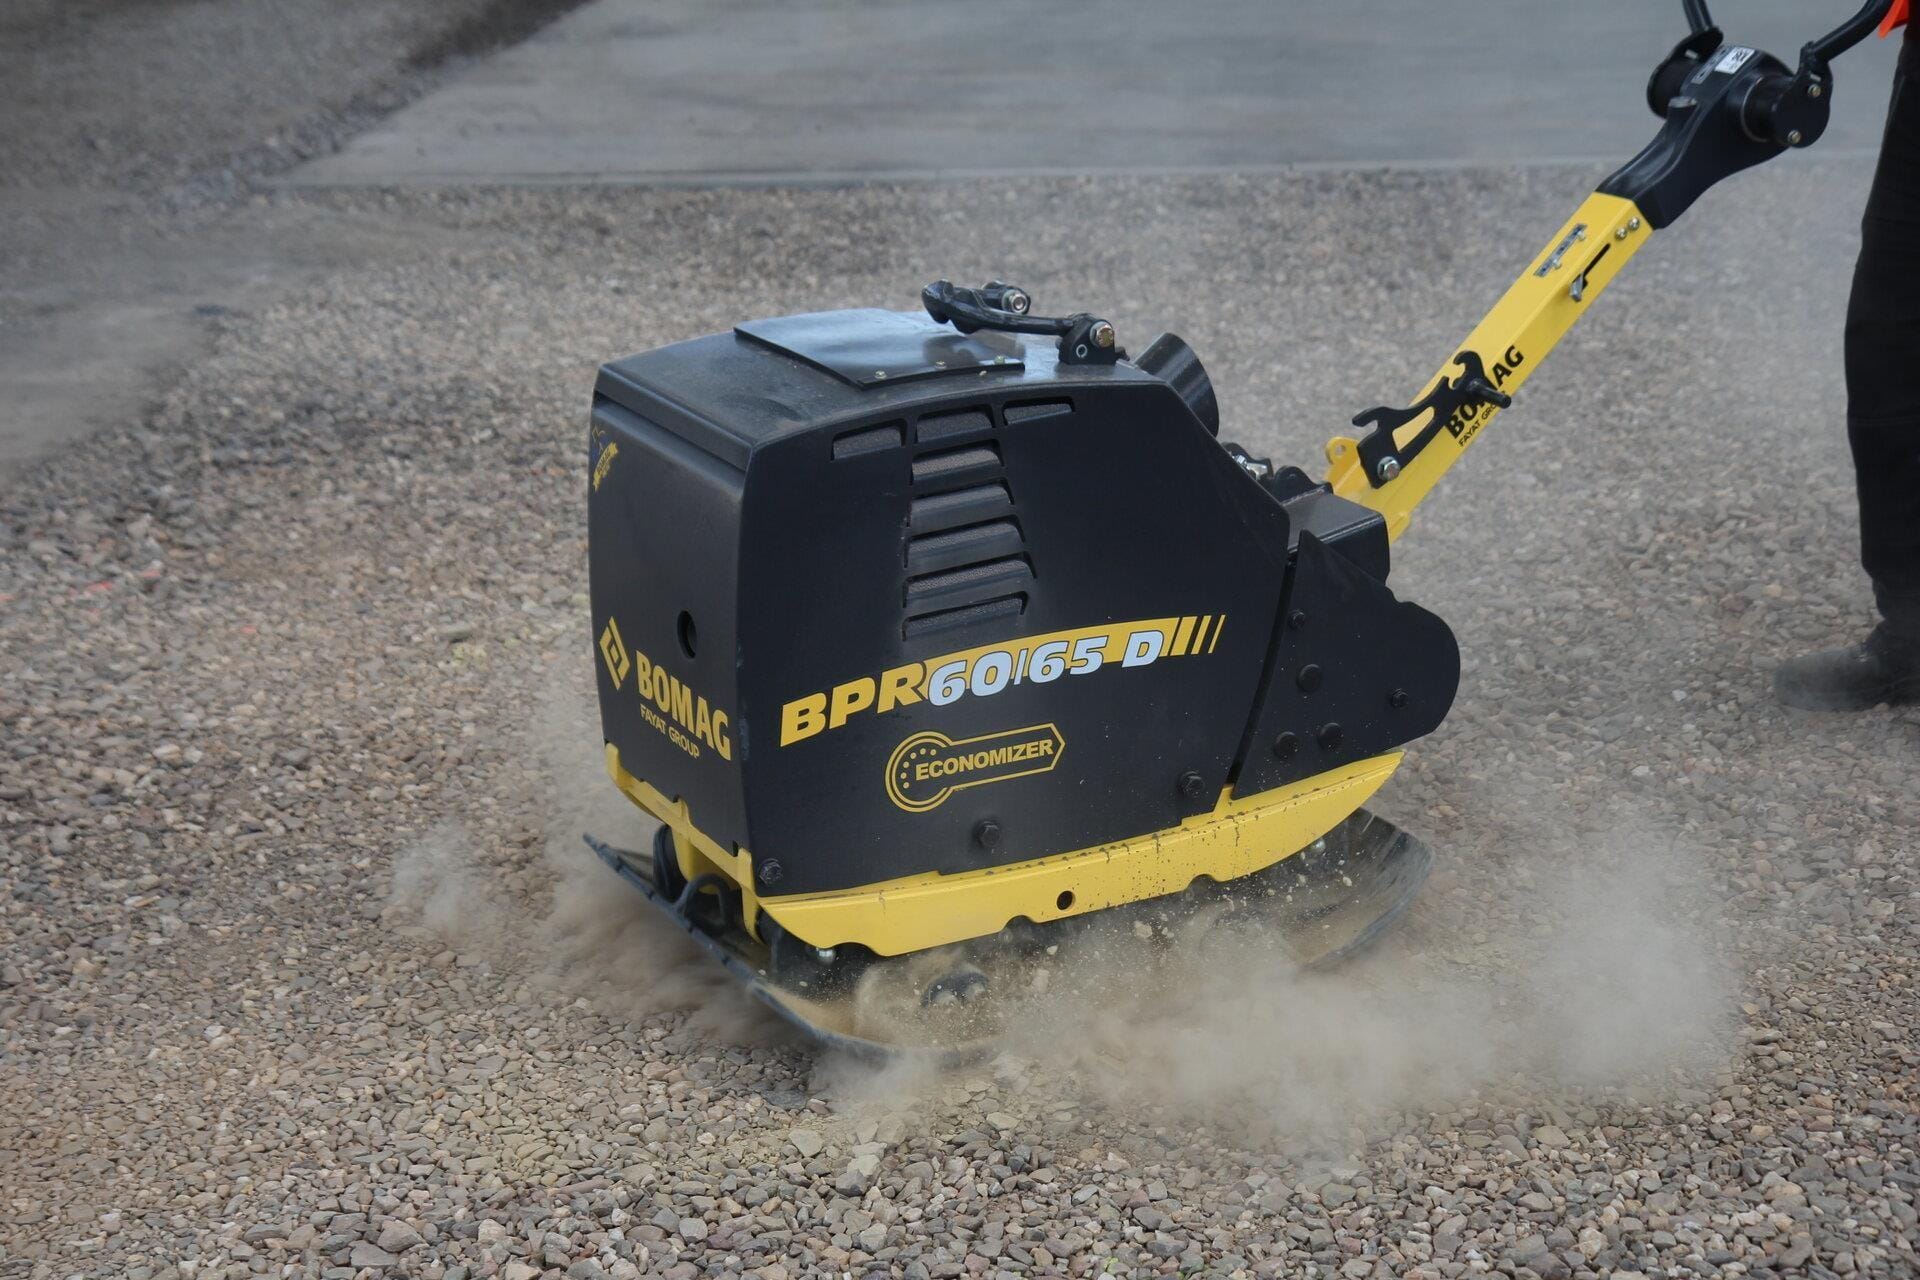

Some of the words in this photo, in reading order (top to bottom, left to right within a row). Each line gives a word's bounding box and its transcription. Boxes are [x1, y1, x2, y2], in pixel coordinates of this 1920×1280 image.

[1446, 345, 1524, 439] BOAG
[1458, 420, 1481, 446] FAYAT
[636, 650, 731, 761] BOMAG
[640, 703, 667, 734] FAYAT
[668, 726, 700, 759] GROUP
[914, 738, 1054, 782] ECONOMIZER
